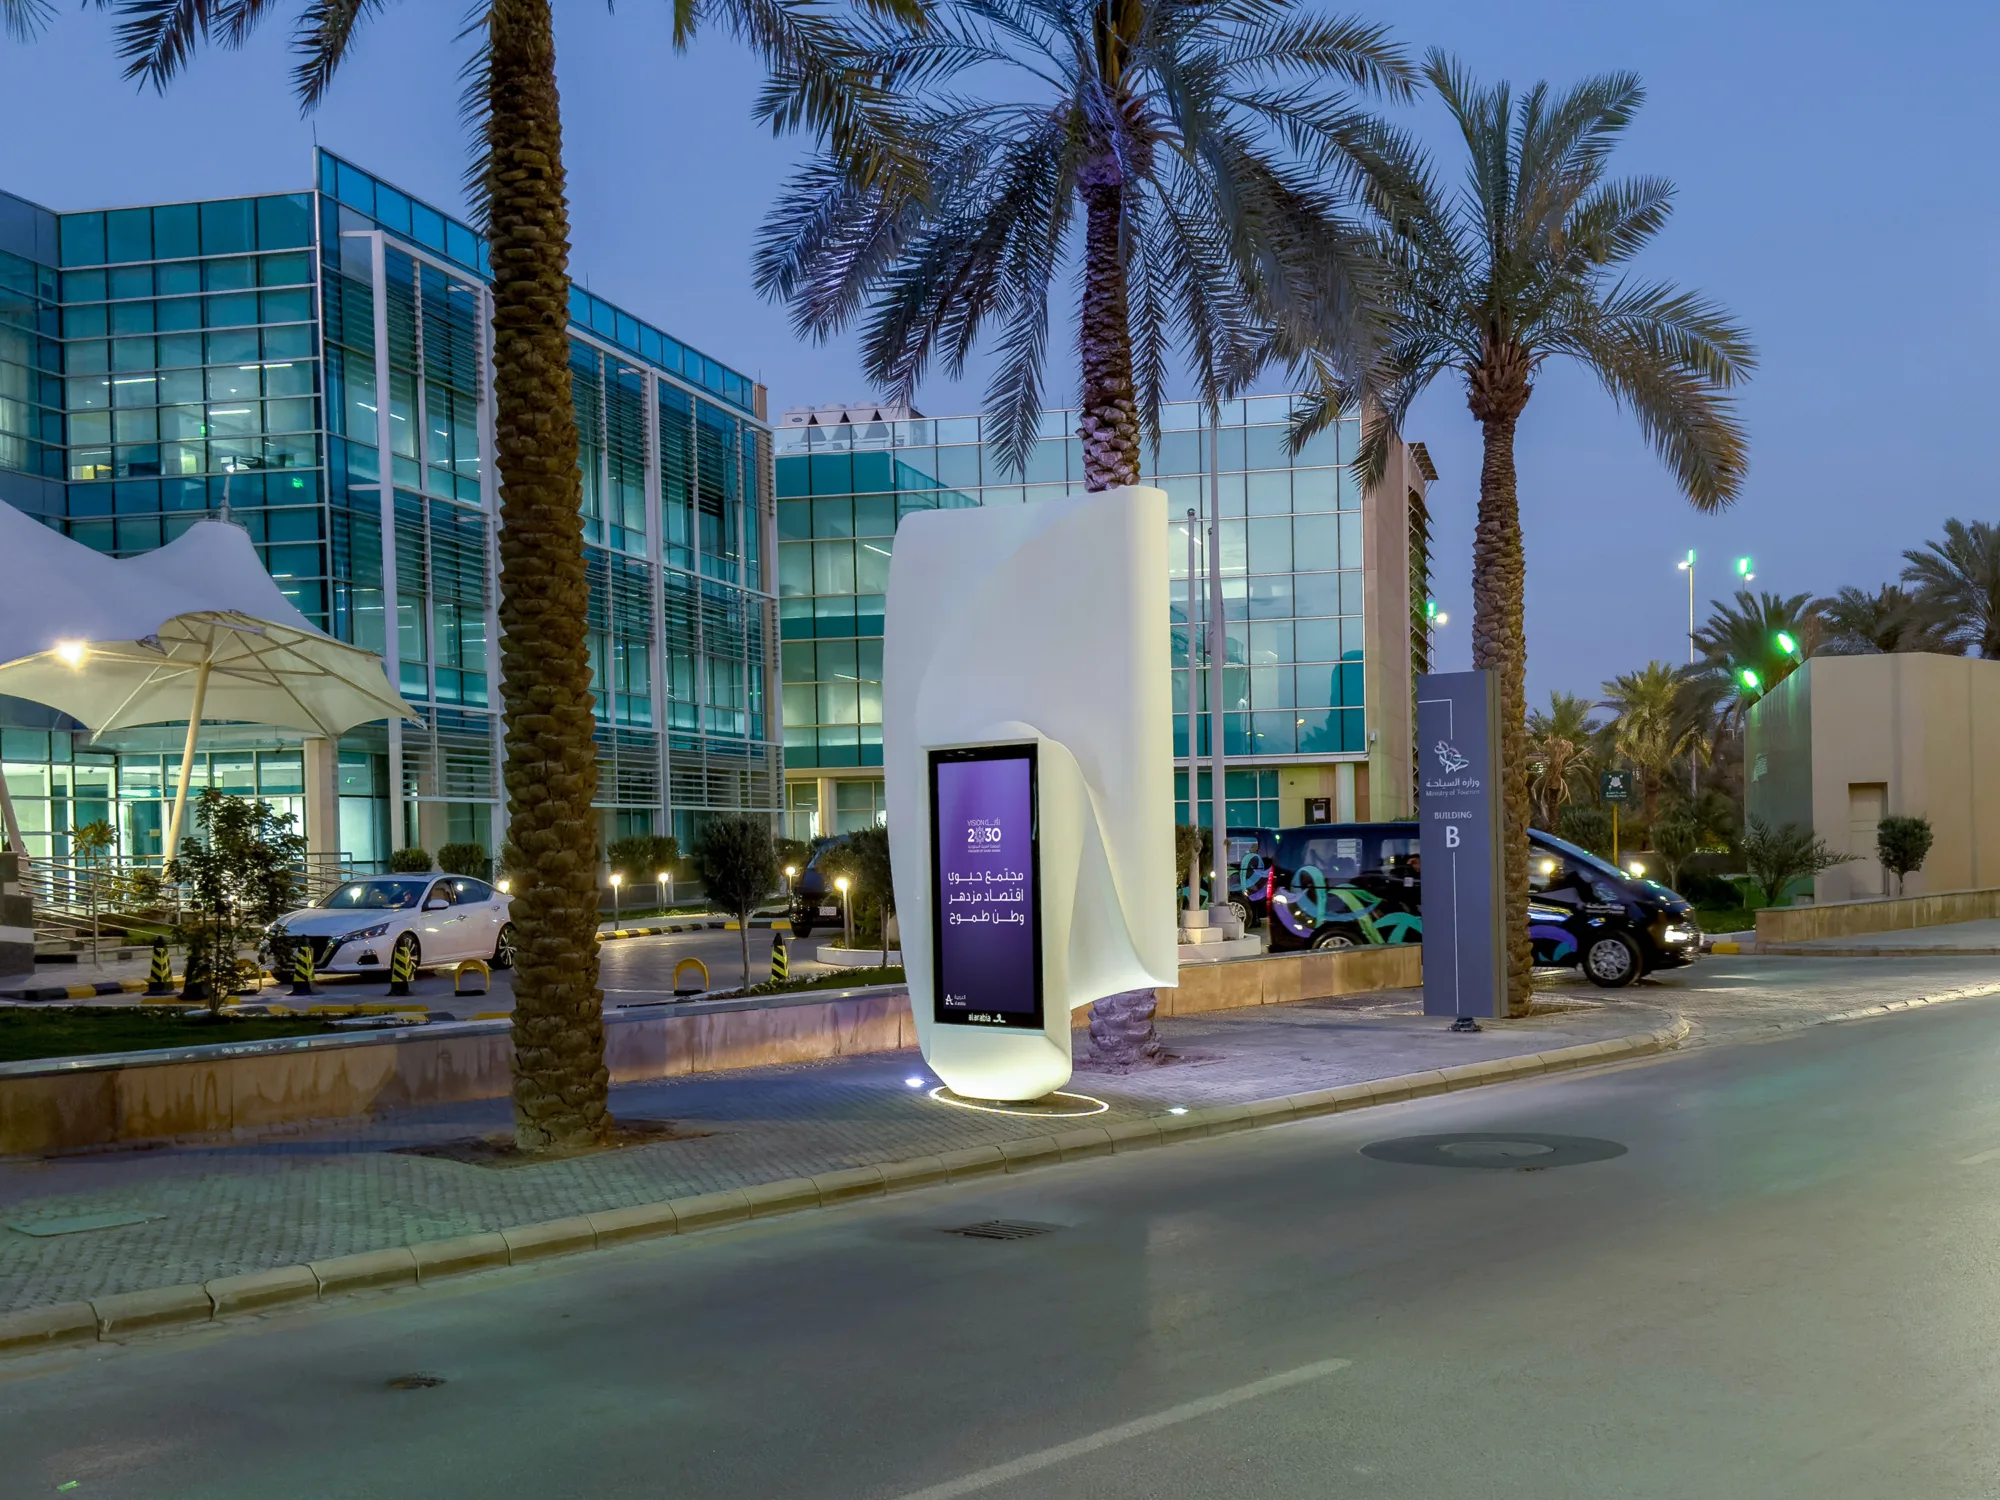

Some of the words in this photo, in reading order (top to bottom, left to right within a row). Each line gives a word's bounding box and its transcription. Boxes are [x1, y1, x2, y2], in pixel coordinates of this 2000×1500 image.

[1425, 777, 1460, 789] السياحة
[1462, 776, 1480, 788] وزارة
[1434, 810, 1473, 820] BUILDING
[1446, 825, 1461, 848] B
[947, 871, 983, 885] حيوي
[985, 868, 1024, 885] مجتمع
[948, 890, 982, 905] مزدهر
[984, 888, 1024, 902] اقتصاد
[949, 909, 990, 925] طموح
[992, 909, 1025, 926] وطن
